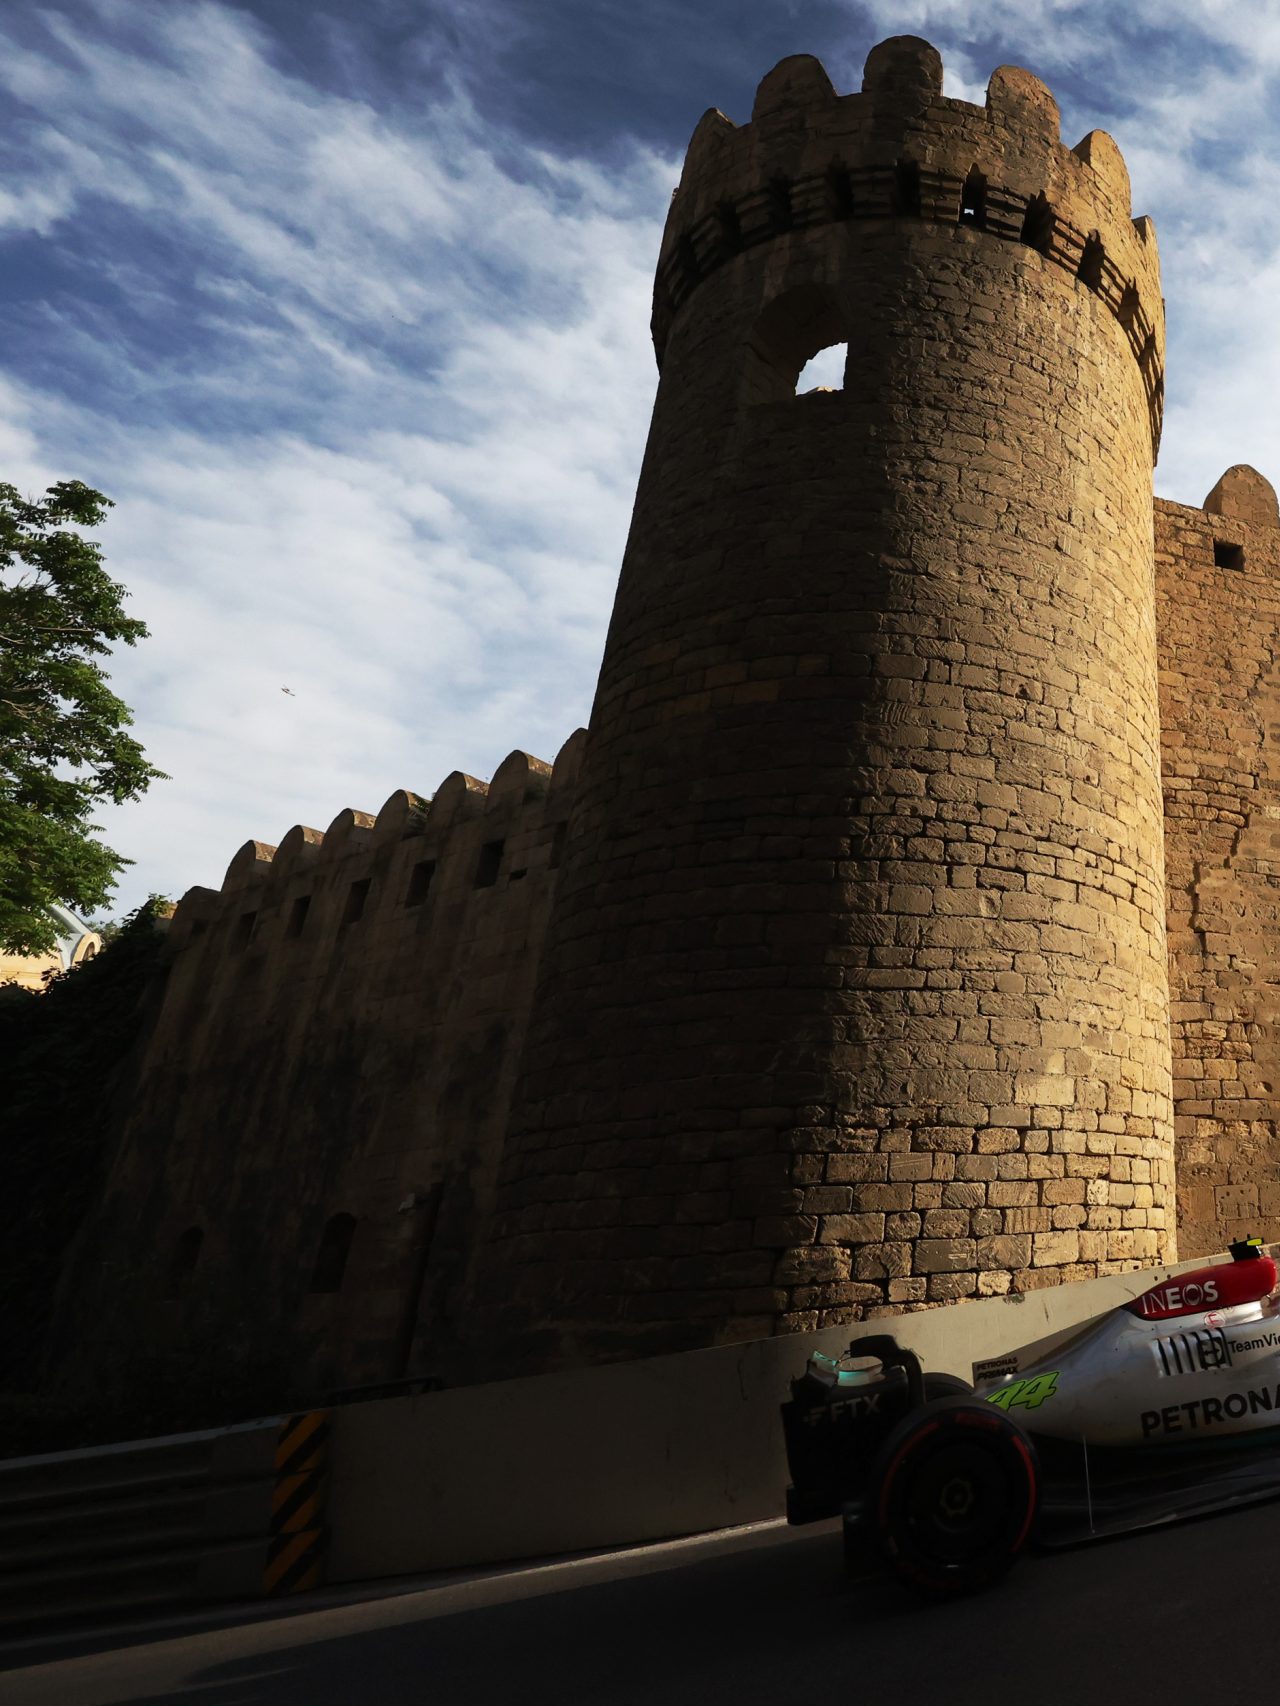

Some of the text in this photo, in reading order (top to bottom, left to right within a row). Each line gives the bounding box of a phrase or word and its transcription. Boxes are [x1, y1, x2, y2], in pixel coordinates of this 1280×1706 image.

[1141, 1280, 1219, 1315] INEOS
[976, 1357, 1018, 1370] PETRONAS
[984, 1370, 1060, 1411] 44
[831, 1393, 880, 1425] FTX
